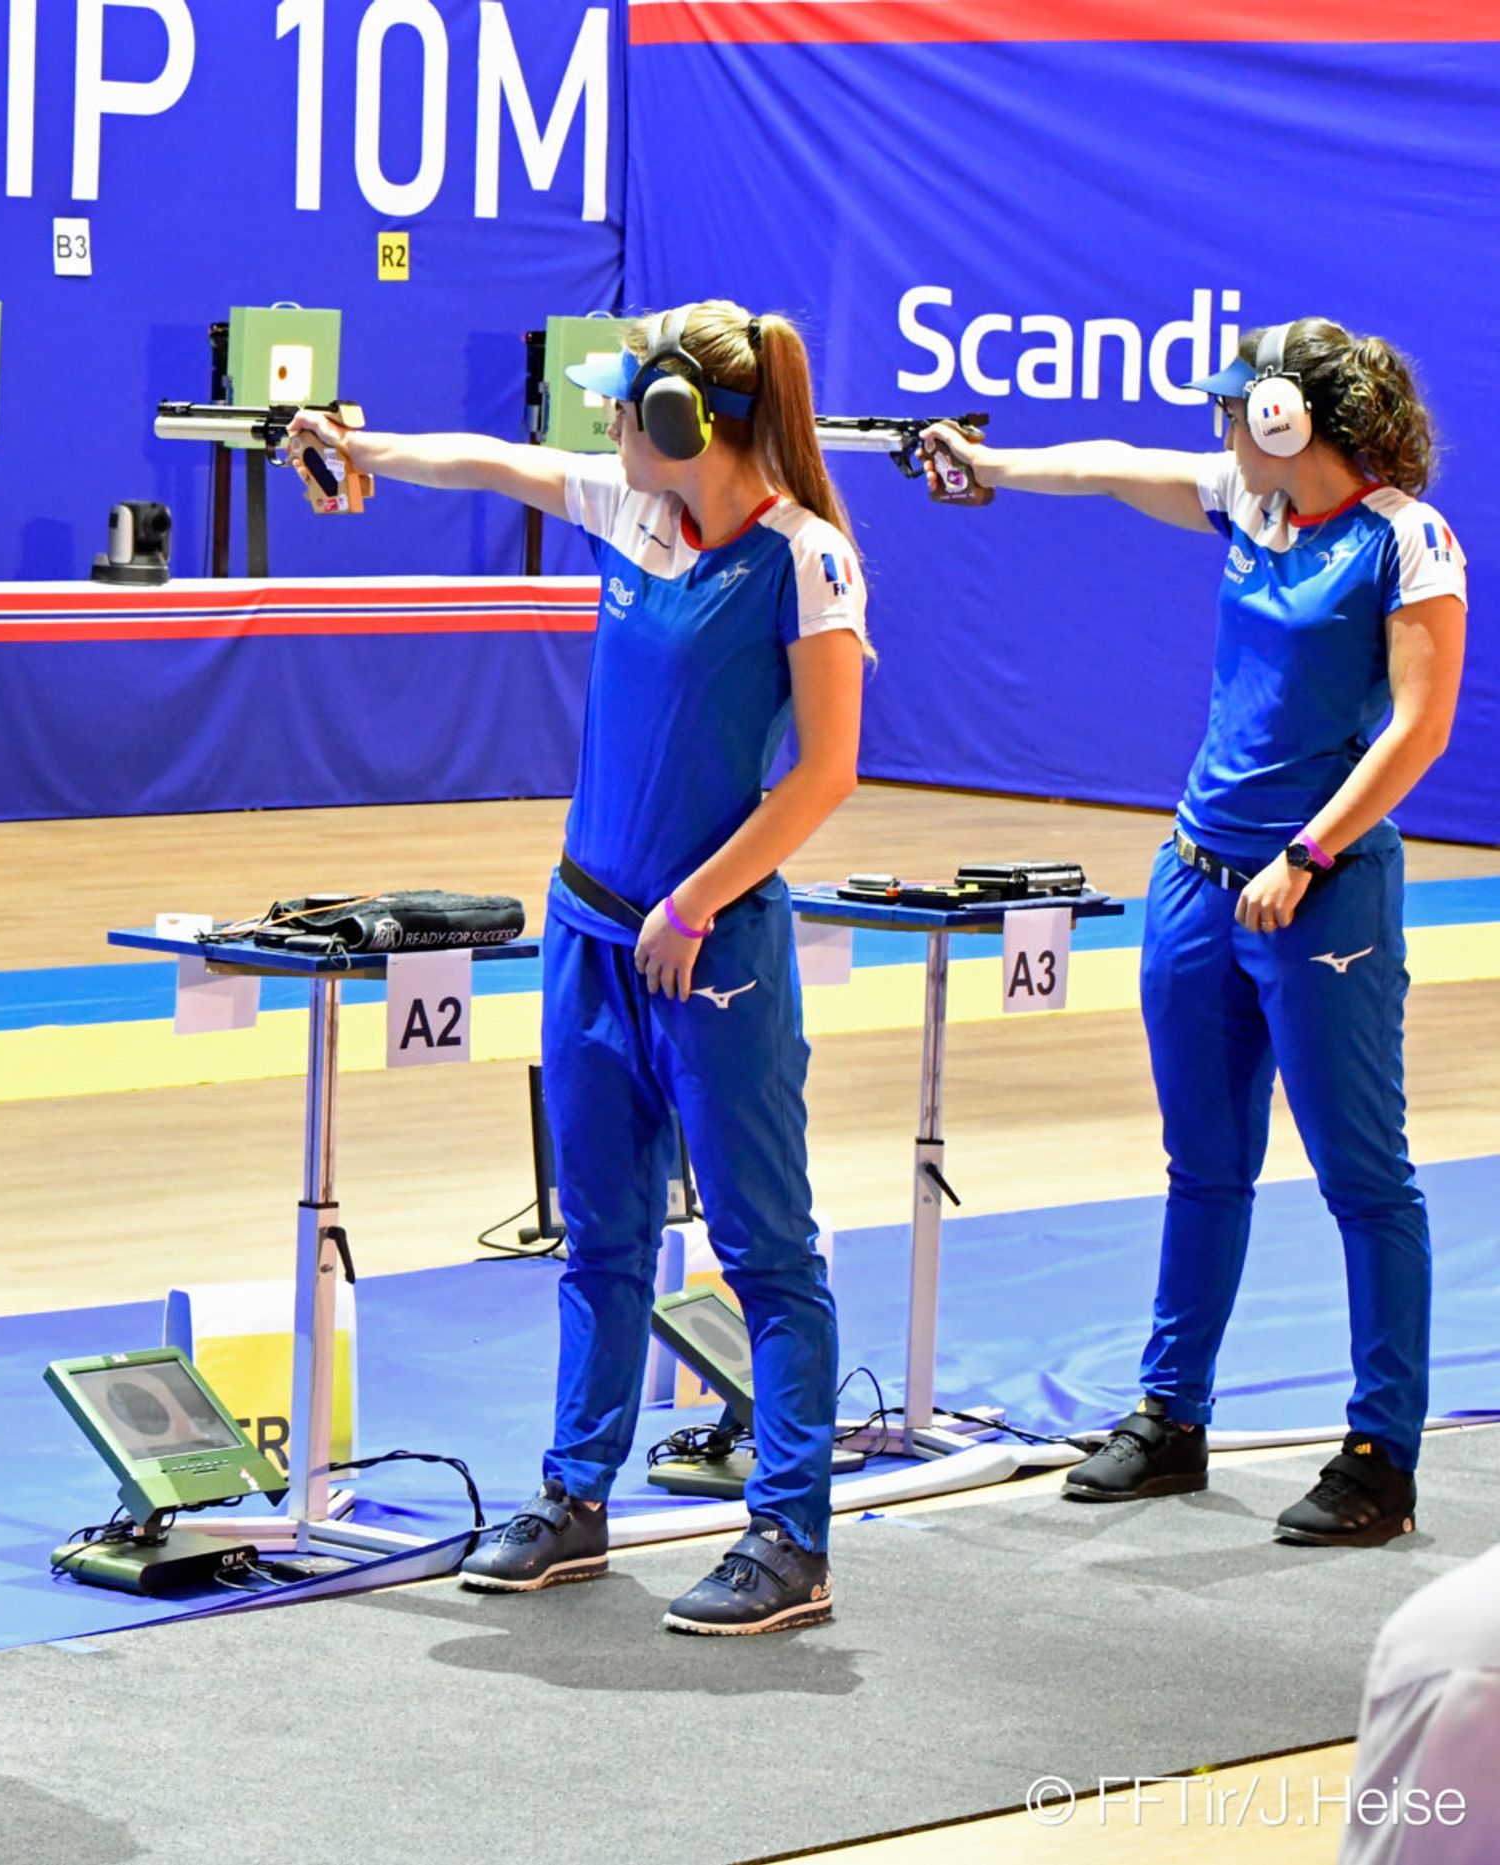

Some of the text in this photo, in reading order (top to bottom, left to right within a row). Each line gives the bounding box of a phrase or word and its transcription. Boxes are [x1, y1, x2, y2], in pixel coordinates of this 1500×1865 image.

[275, 0, 609, 222] 10M
[56, 234, 88, 258] B3
[381, 244, 406, 269] R2
[897, 286, 1241, 406] Scandi
[403, 931, 446, 945] READY
[446, 930, 468, 944] FOR
[1008, 950, 1057, 998] A3
[399, 996, 463, 1050] A2
[235, 1416, 290, 1471] R
